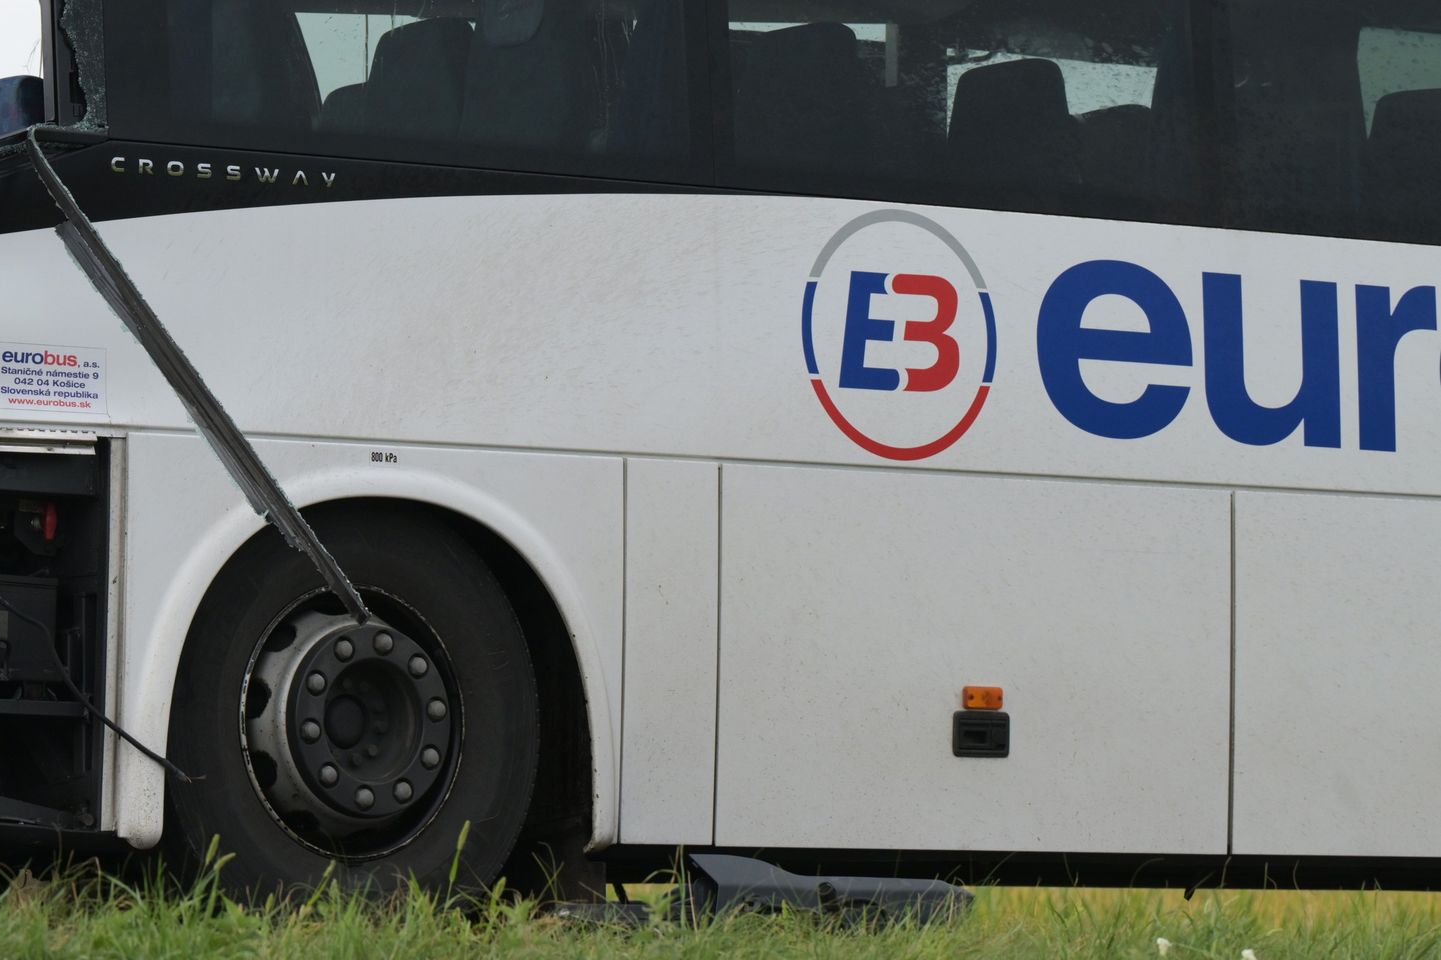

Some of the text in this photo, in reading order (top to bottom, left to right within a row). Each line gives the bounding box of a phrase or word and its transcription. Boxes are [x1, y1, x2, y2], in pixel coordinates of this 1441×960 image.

[111, 157, 336, 188] CROSSWAY
[2, 350, 100, 369] eurobus, a.s.
[1036, 259, 1441, 453] eur
[0, 366, 99, 380] Staničné námestie 9
[14, 377, 86, 389] 042 04 Košice
[0, 386, 99, 400] Slovenská republika
[8, 397, 91, 409] www.eurobus.sk
[385, 452, 398, 463] kPa
